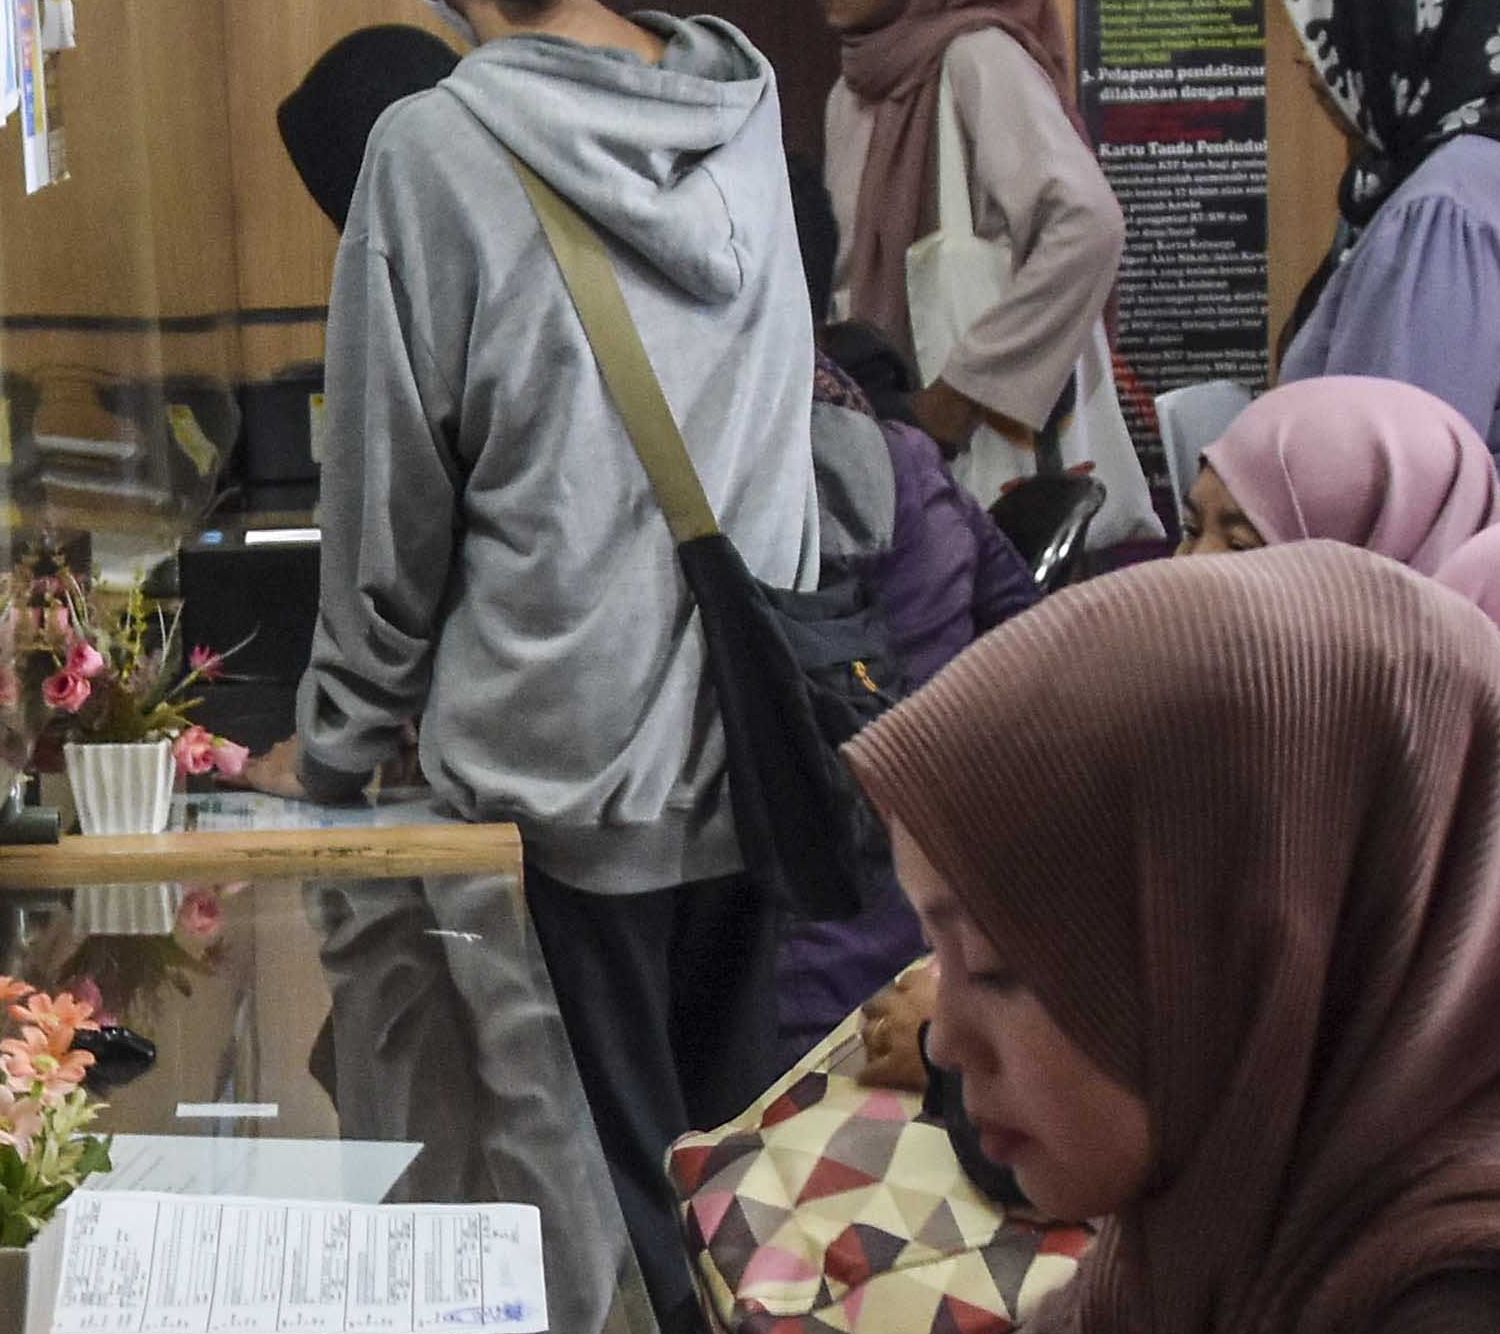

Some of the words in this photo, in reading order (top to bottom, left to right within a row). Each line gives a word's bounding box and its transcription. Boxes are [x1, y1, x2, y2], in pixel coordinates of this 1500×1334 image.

[1100, 85, 1177, 100] dilakukan
[1180, 84, 1234, 101] dengan
[1148, 141, 1193, 155] Tanda
